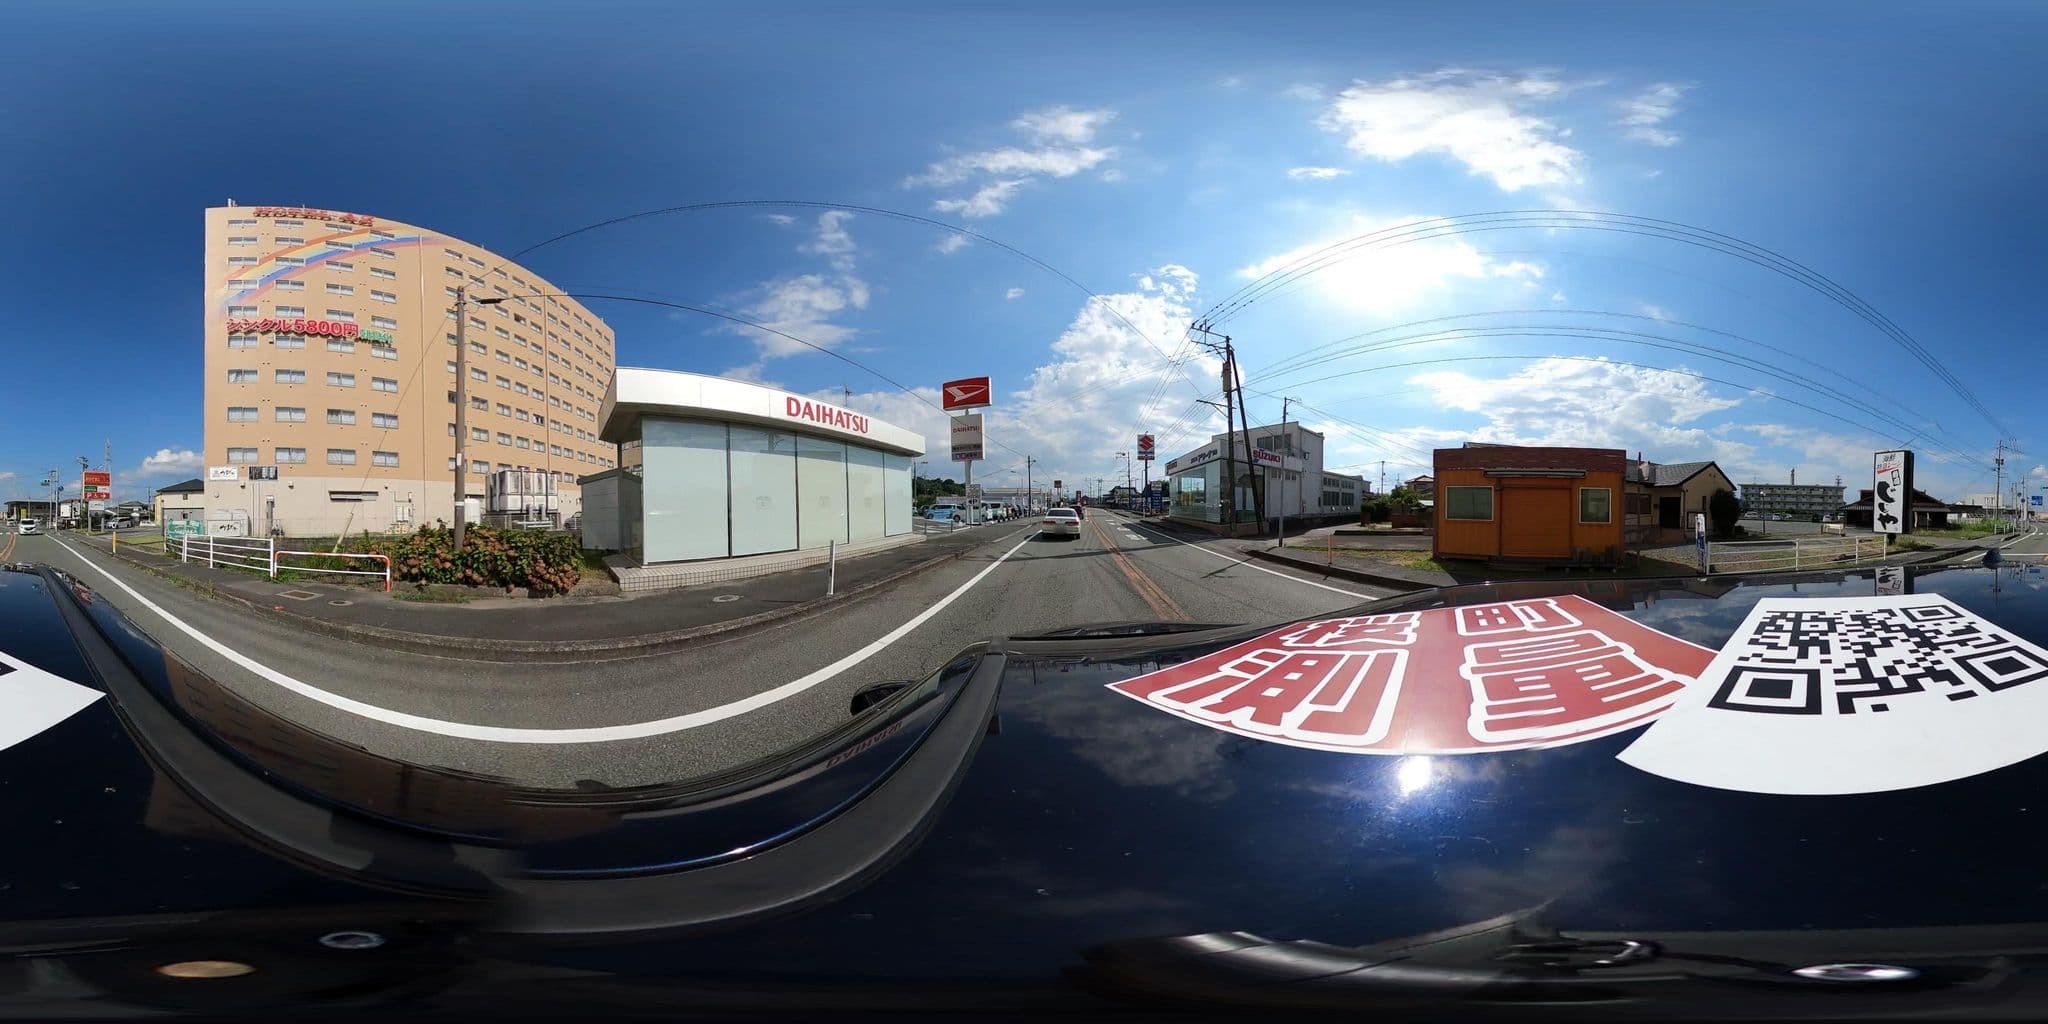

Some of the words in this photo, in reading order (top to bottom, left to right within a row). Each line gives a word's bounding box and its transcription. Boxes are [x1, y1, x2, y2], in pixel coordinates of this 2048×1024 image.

[786, 396, 869, 434] DAIHATSU
[952, 424, 980, 434] DAIHATSU
[1252, 449, 1281, 463] SUZUKI
